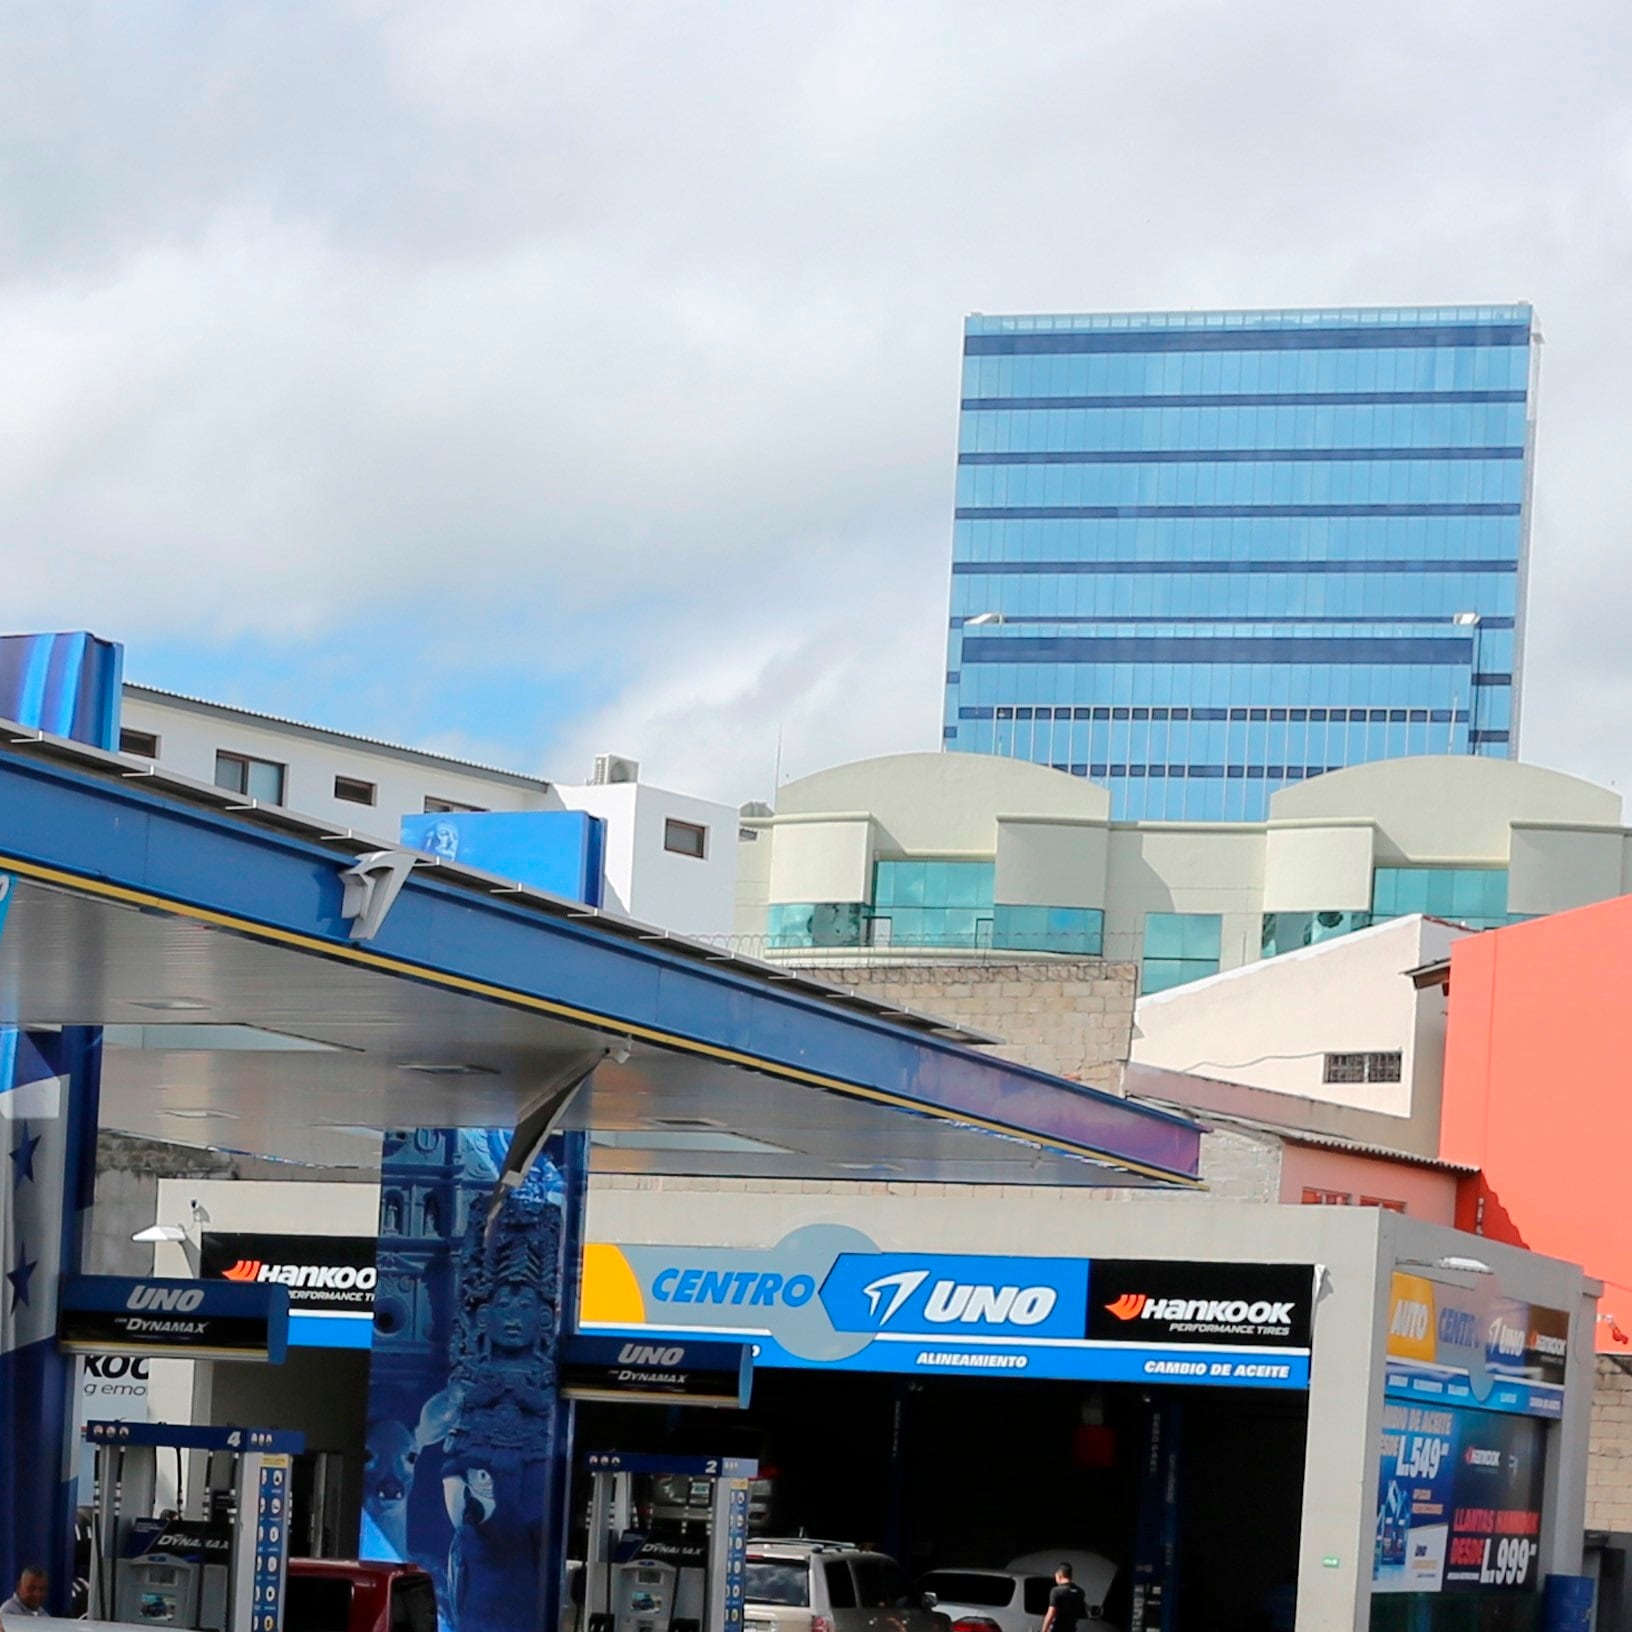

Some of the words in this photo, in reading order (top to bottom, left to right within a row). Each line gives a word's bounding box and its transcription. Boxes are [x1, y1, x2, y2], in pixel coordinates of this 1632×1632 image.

[651, 1267, 815, 1308] CENTRO
[126, 1285, 205, 1312] UNO
[923, 1280, 1057, 1326] UNO
[126, 1317, 209, 1334] DYNAMAX
[1169, 1322, 1255, 1335] PERFORMANCE
[1256, 1325, 1291, 1336] TIRES
[1389, 1299, 1429, 1341] AUTO
[618, 1343, 685, 1366] UNO
[916, 1352, 1028, 1369] ALINEAMIENTO
[618, 1370, 688, 1384] DYNAMAX
[1144, 1360, 1208, 1376] CAMBIO
[1209, 1363, 1232, 1377] DE
[1233, 1365, 1290, 1379] ACEITE
[226, 1431, 242, 1448] 4
[705, 1459, 718, 1474] 2
